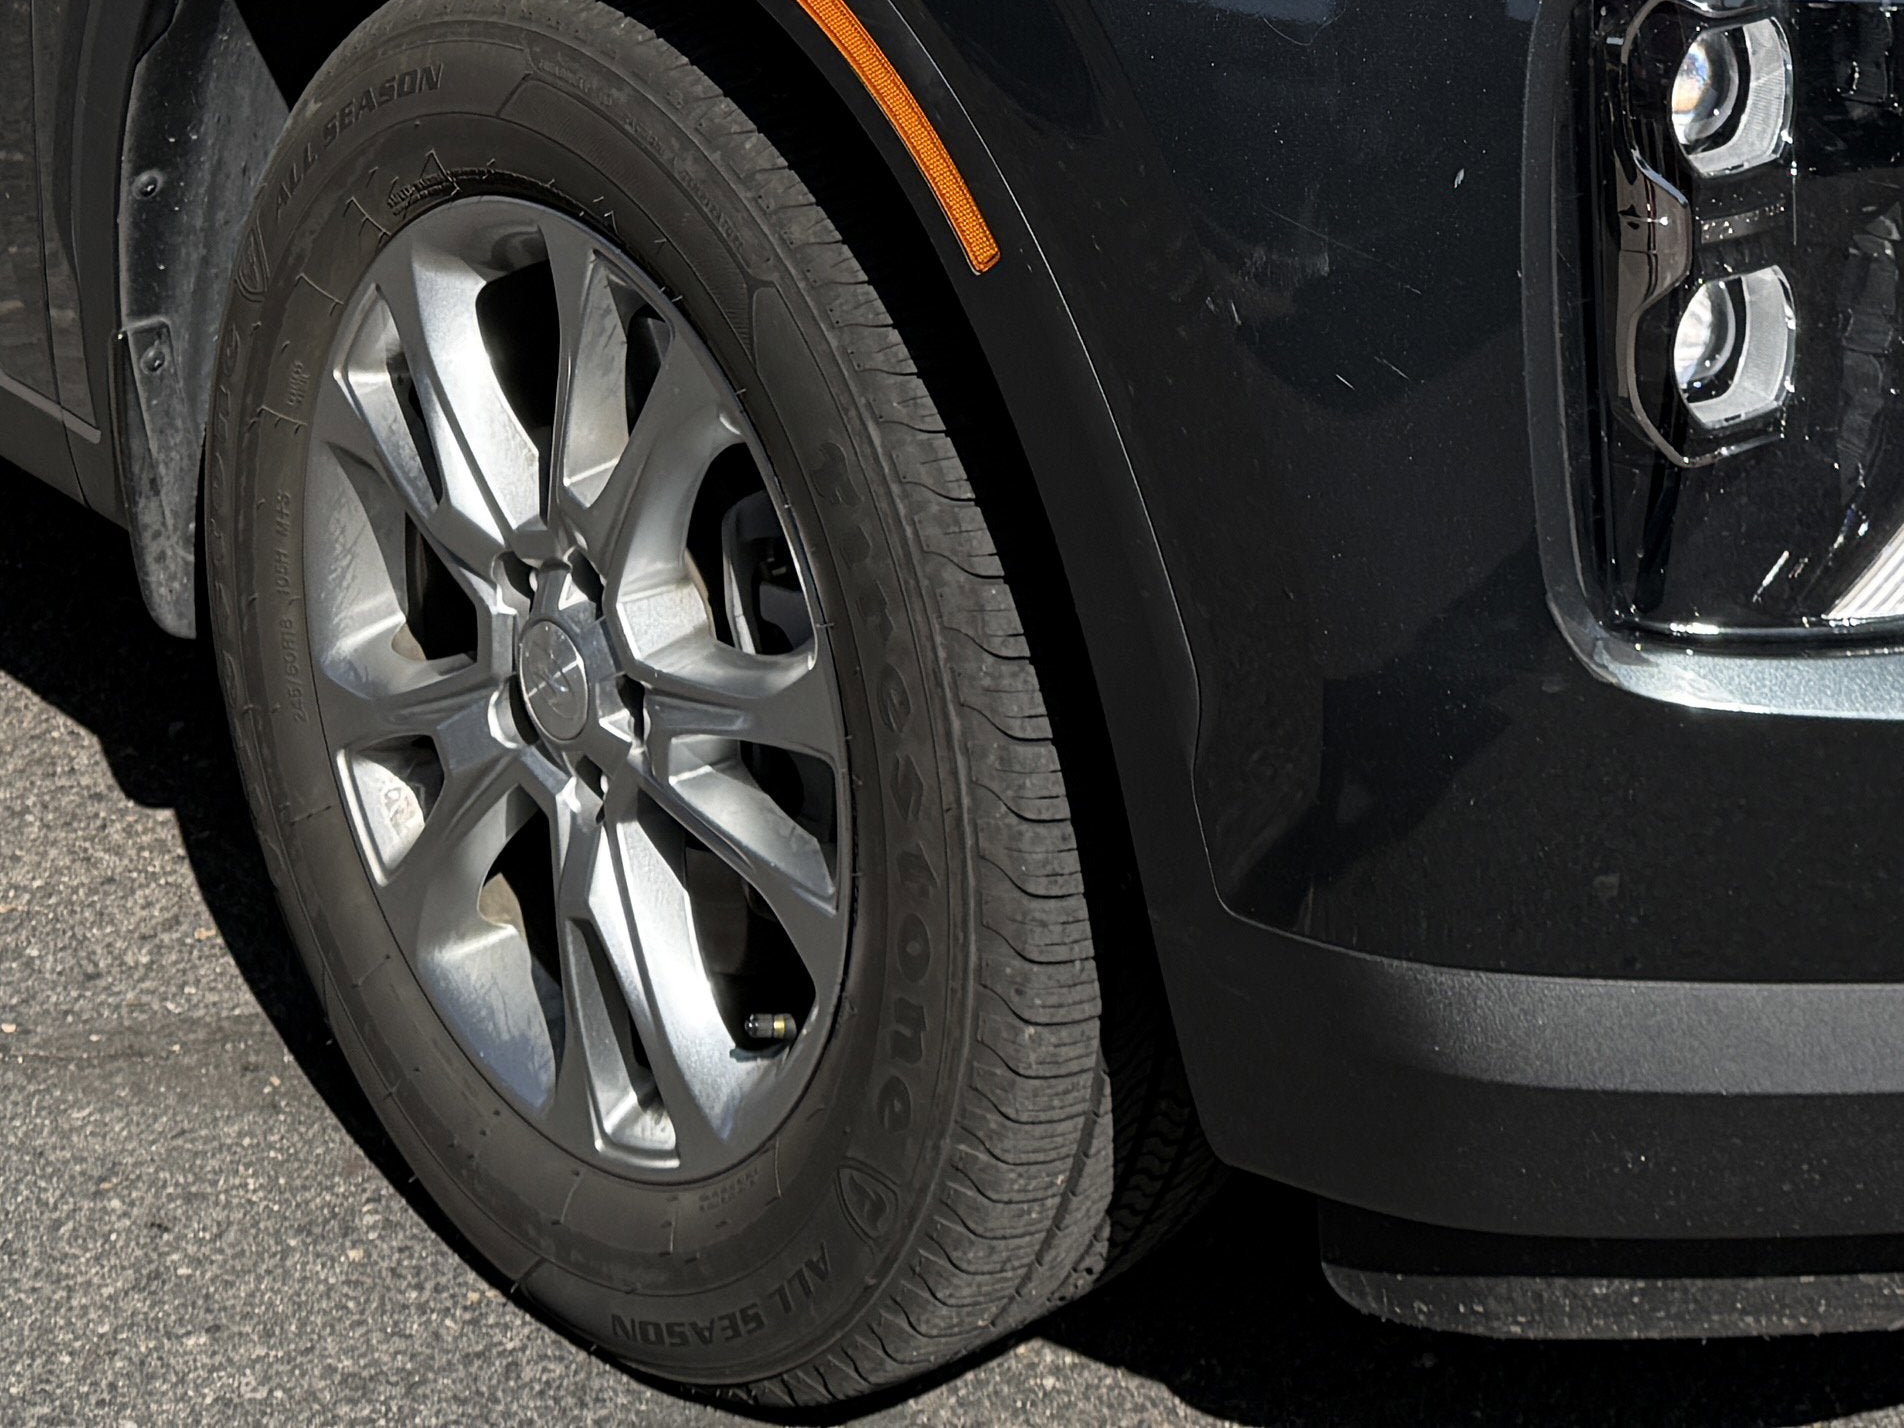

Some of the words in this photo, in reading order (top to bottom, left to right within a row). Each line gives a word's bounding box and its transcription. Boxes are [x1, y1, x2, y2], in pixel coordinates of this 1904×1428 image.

[276, 141, 319, 215] ALL
[323, 63, 445, 149] SEASON
[767, 1241, 832, 1315] ALL
[609, 1301, 766, 1347] SEASON
